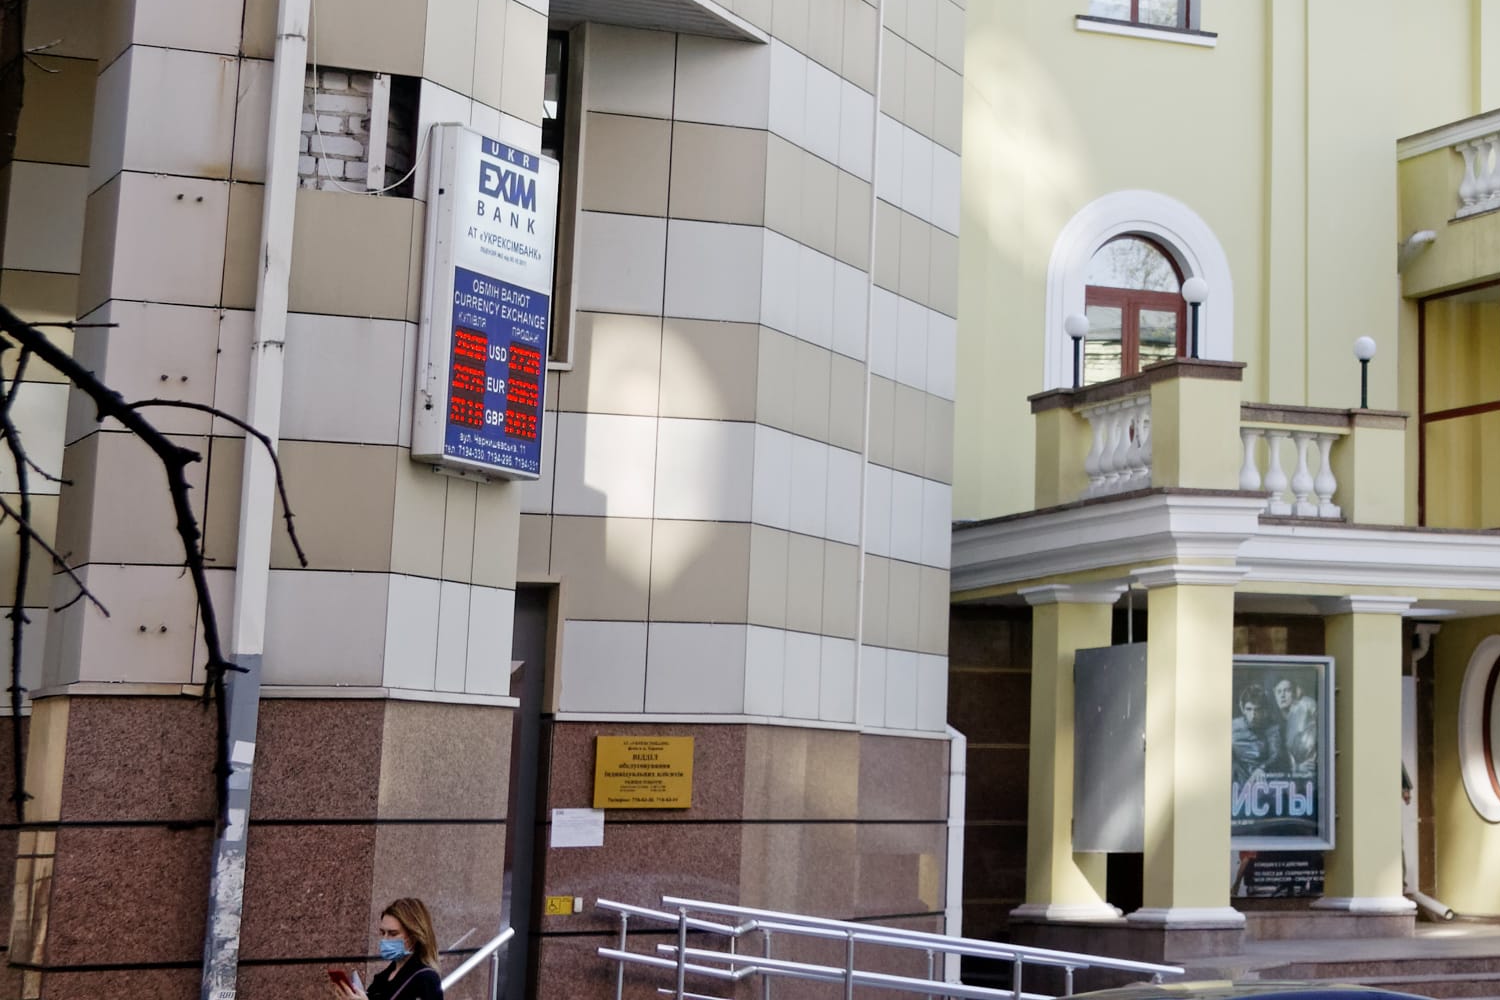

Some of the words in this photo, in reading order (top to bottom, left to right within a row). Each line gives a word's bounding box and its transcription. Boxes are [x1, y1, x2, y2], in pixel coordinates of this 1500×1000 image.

[491, 141, 530, 168] UKR
[479, 160, 536, 213] EXIM
[477, 200, 535, 235] BANK
[467, 226, 478, 239] АТ
[472, 279, 500, 299] ОБМІН
[501, 288, 531, 308] ВАЛЮТ
[454, 291, 500, 316] CURRENCY
[501, 305, 545, 330] EXCHANGE
[489, 344, 507, 362] USD
[486, 376, 505, 394] EUR
[485, 409, 504, 426] GBP
